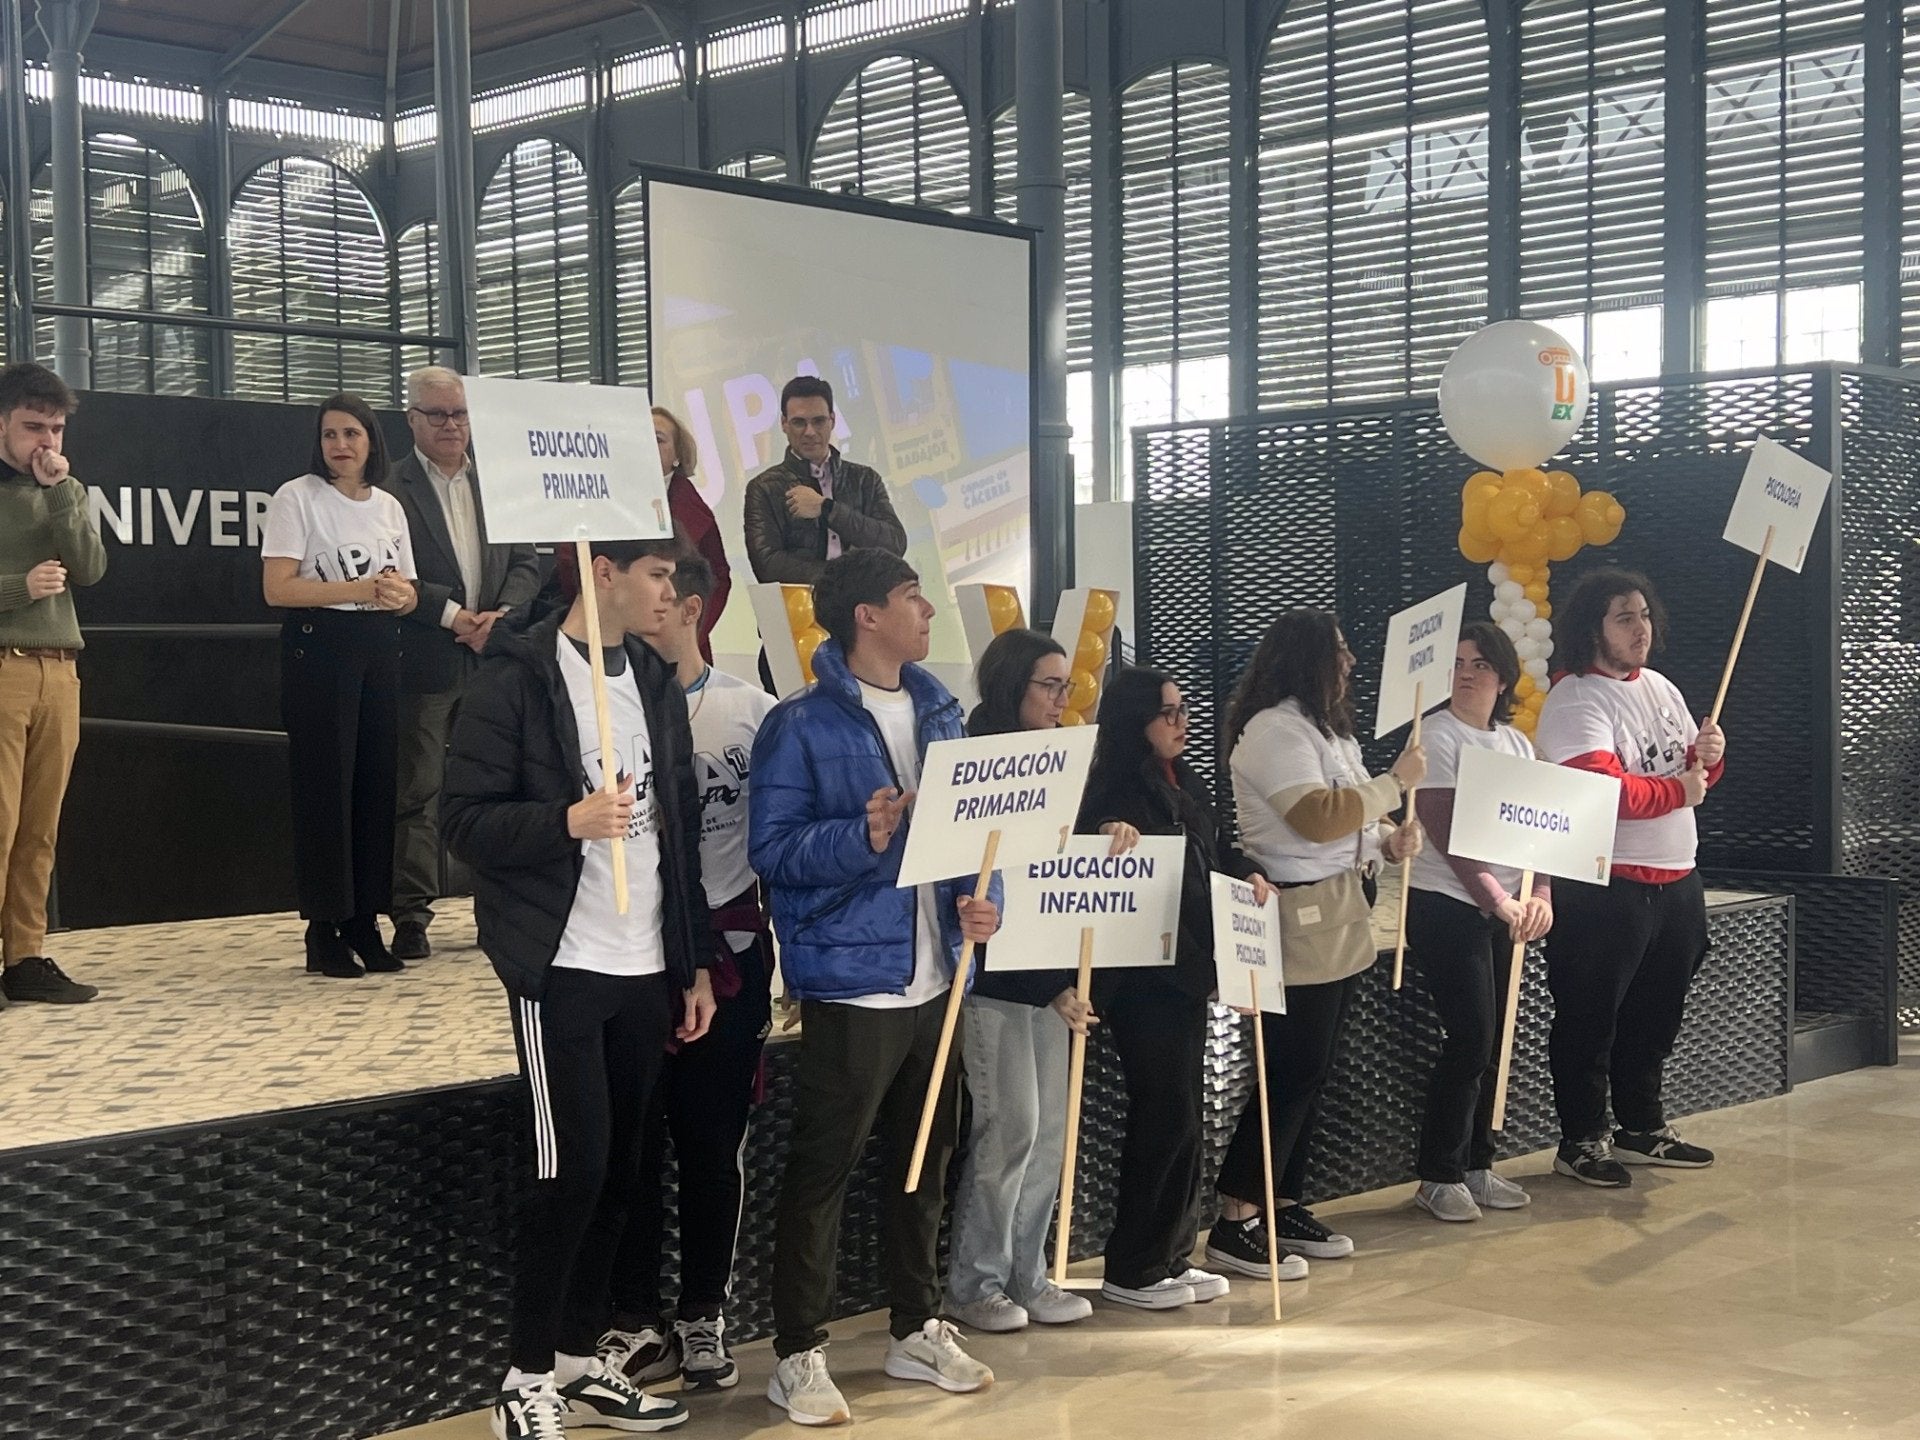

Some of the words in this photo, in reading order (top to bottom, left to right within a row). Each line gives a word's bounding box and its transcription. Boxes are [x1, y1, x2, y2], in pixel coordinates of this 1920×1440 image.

[1551, 404, 1574, 421] EX
[528, 424, 610, 458] EDUCACIÓN
[542, 473, 610, 499] PRIMARIA
[951, 744, 1067, 786] EDUCACIÓN
[953, 787, 1046, 822] PRIMARIA
[1499, 802, 1570, 834] PSICOLOGÍA
[1028, 849, 1155, 879] EDUCACIÓN
[1040, 891, 1137, 914] INFANTIL
